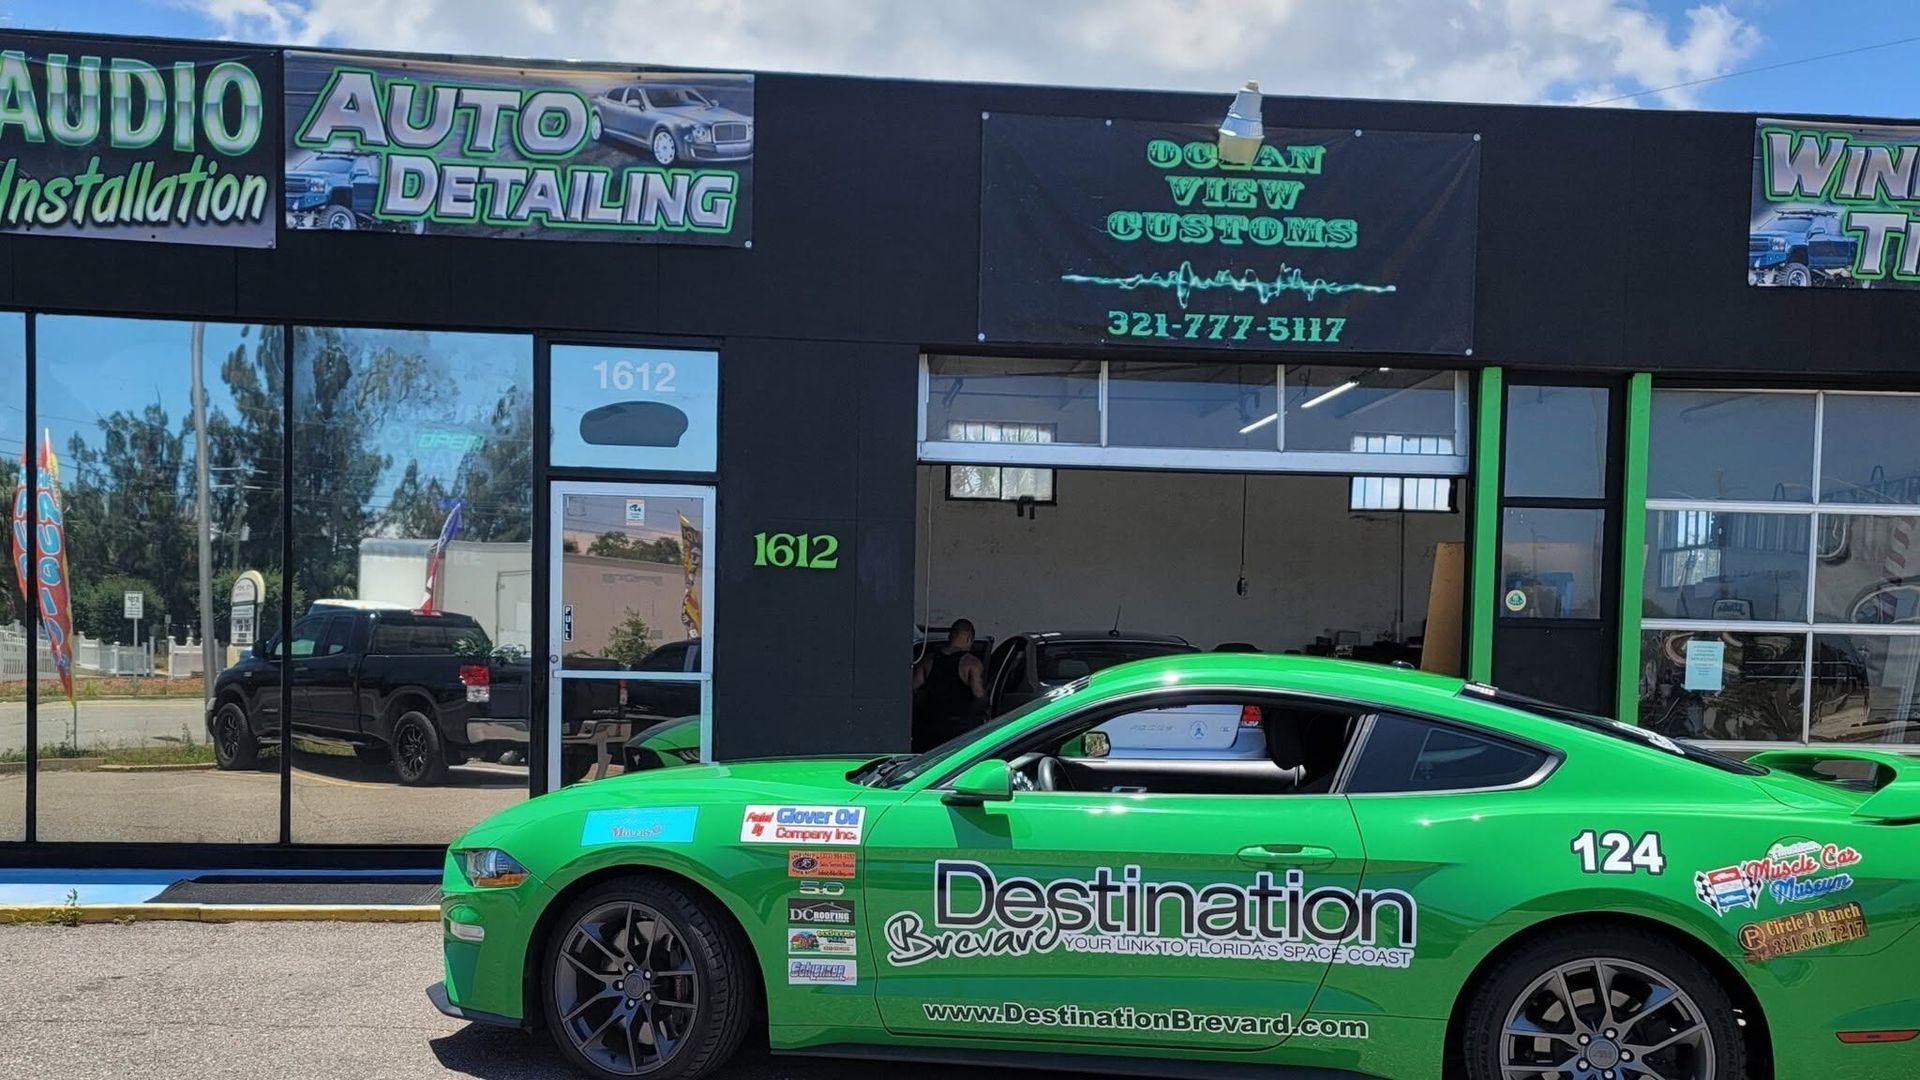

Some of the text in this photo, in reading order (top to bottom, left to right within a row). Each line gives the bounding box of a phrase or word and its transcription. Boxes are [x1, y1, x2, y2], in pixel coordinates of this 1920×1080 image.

[0, 50, 263, 156] AUDIO
[297, 68, 592, 158] AUTO
[1147, 139, 1326, 174] OCAN
[1764, 131, 1920, 201] WIN
[0, 154, 267, 225] Installation
[379, 153, 737, 230] DETAILING
[1165, 176, 1304, 209] VIEW
[1107, 211, 1358, 248] CUSTOMS
[1107, 310, 1347, 342] 321-777-5117
[593, 360, 676, 392] 1612
[754, 532, 839, 569] 1612
[564, 605, 573, 641] PULL
[776, 808, 833, 825] Glover
[776, 827, 833, 842] Company
[1571, 830, 1666, 874] 124
[1746, 844, 1862, 882] Muscle Car
[800, 881, 845, 895] 5.0
[936, 861, 1415, 945] Destination
[1771, 874, 1853, 903] Museum
[789, 908, 813, 920] DC
[1766, 903, 1861, 936] Circle P Ranch
[1064, 935, 1411, 965] YOUR LINK TO FLORIDA'S SPACE COAST
[922, 1002, 1369, 1038] www.DestinationBrevard.com
